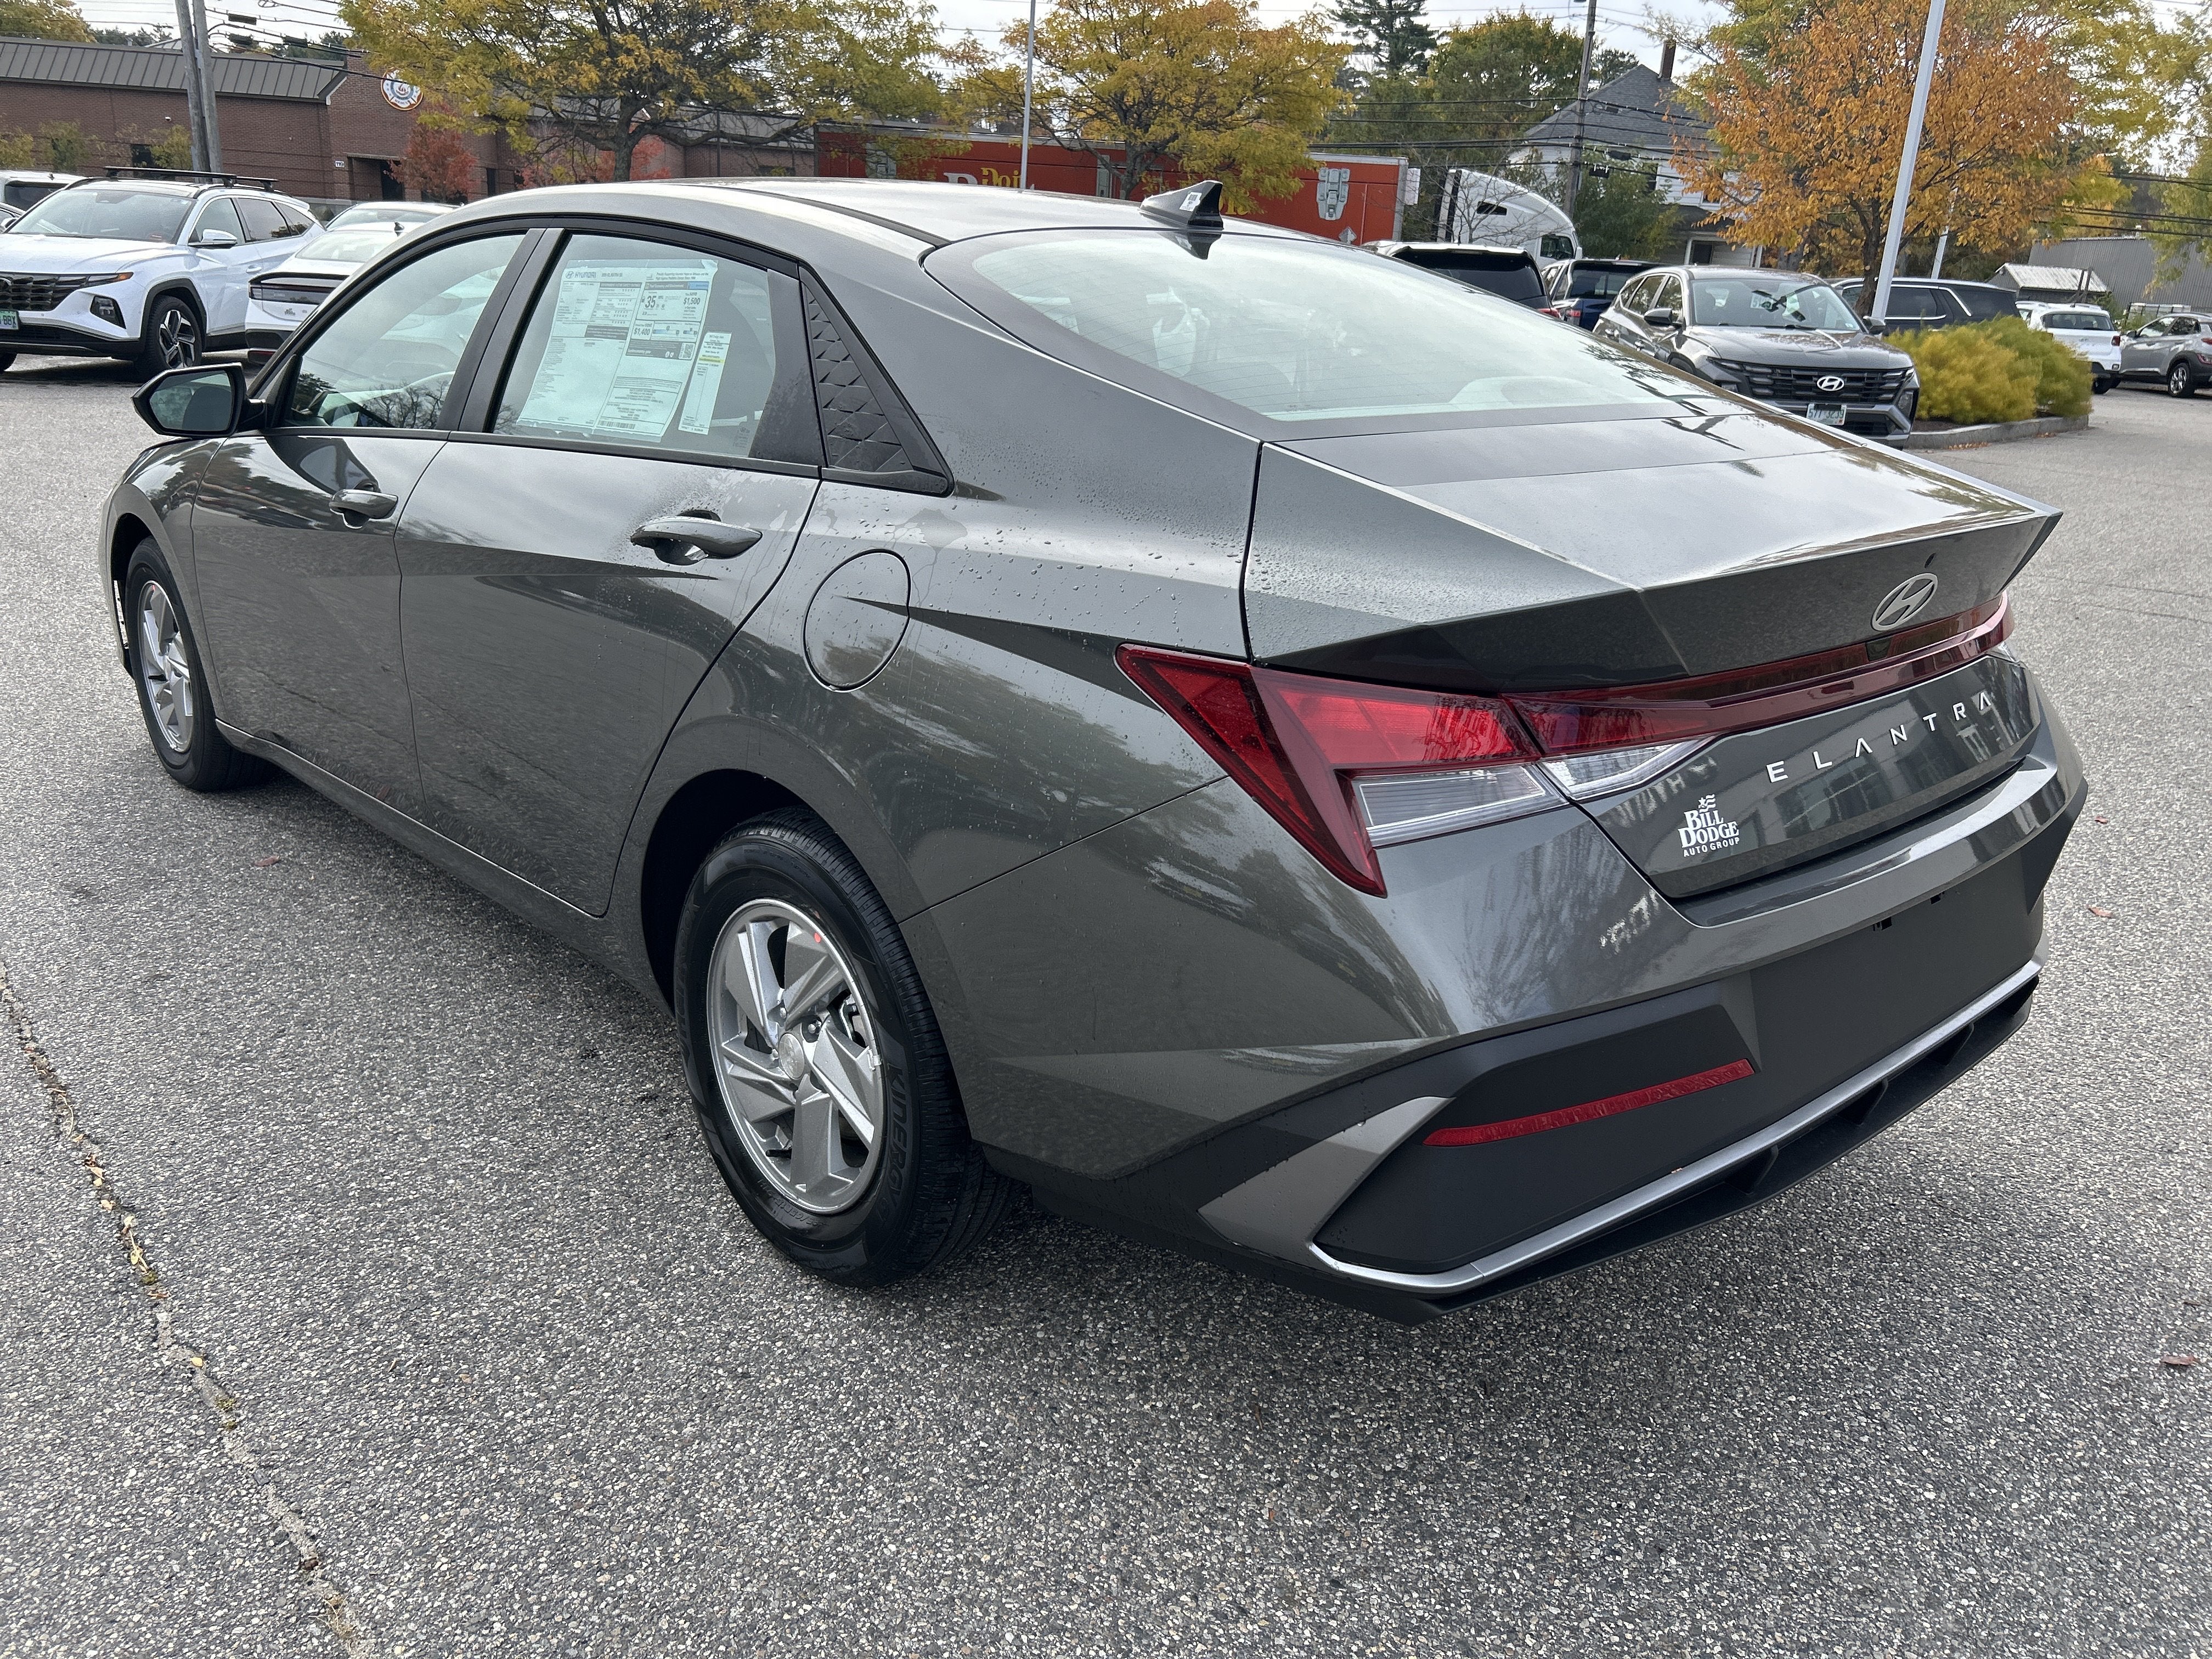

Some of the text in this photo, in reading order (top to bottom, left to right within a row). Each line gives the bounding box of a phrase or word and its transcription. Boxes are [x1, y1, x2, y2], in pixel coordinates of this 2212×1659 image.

[645, 295, 657, 308] 35
[683, 297, 701, 306] $1,500
[634, 328, 651, 336] $1,400
[1766, 691, 1991, 783] ELANTRA
[1683, 837, 1740, 857] AUTO GROUP
